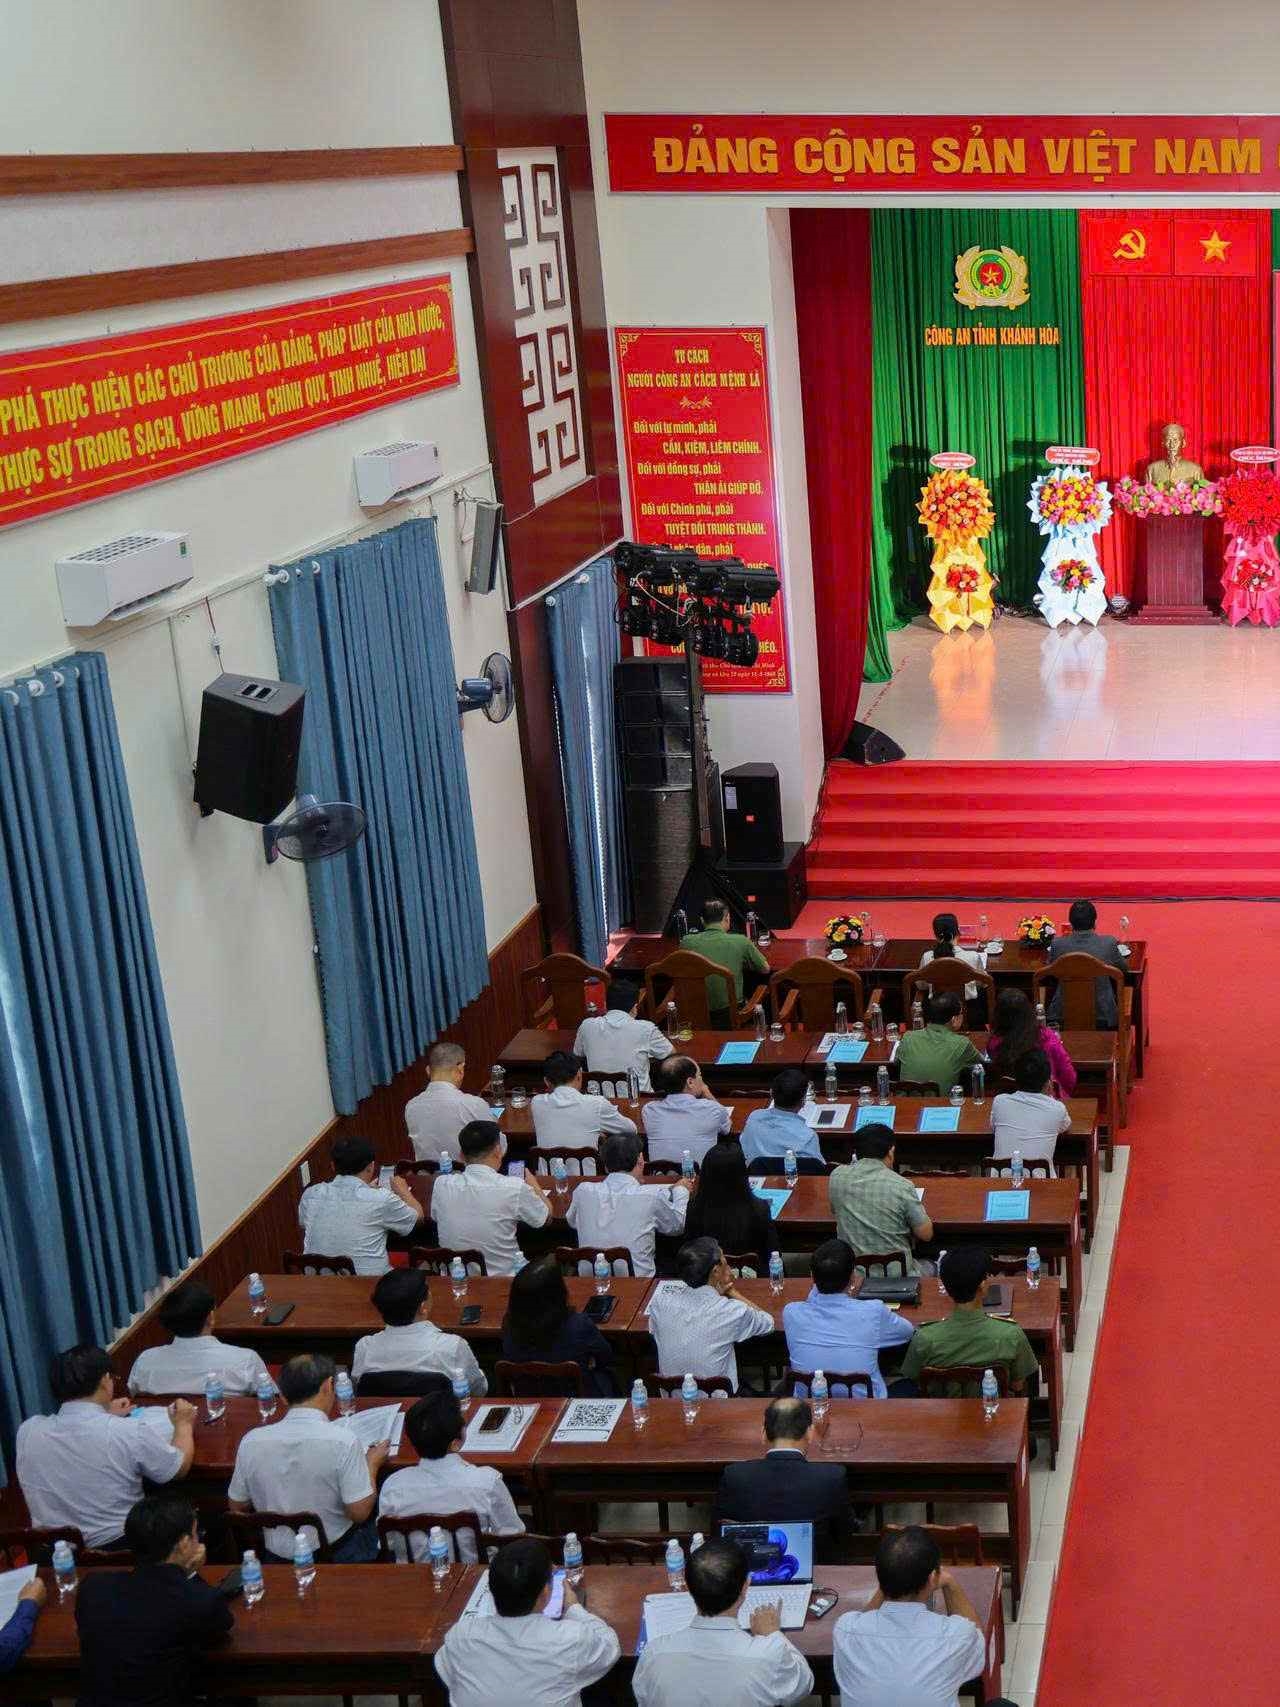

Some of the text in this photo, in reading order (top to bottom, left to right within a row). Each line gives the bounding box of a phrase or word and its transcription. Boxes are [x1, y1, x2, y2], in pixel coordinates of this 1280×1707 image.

[653, 124, 777, 175] ĐẢNG
[794, 128, 916, 182] CỘNG
[931, 124, 1025, 175] SẢN
[1044, 128, 1136, 182] VIỆT
[1154, 137, 1261, 174] NAM
[0, 386, 41, 435] PHÁ
[41, 382, 90, 429] THỰC
[91, 371, 133, 418] HIỆN
[134, 363, 167, 405] CÁC
[168, 351, 199, 397] CHỦ
[200, 349, 254, 389] TRƯƠNG
[255, 334, 281, 375] CỦA
[281, 329, 318, 369] ĐẢNG,
[318, 323, 347, 359] PHÁP
[349, 316, 374, 354] LUẬT
[374, 308, 396, 344] CỦA
[396, 305, 417, 339] NHÀ
[925, 322, 1060, 345] CÔNG AN TỈNH KHÁNH HÒA
[47, 438, 73, 483] SỰ
[74, 427, 132, 471] TRONG
[134, 416, 181, 460] SẠCH,
[181, 403, 220, 443] VỮNG
[221, 392, 266, 434] MẠNH,
[266, 379, 304, 417] CHÍNH
[330, 366, 355, 397] TINH
[386, 347, 410, 384] HIỆN
[410, 346, 427, 377] ĐẠI
